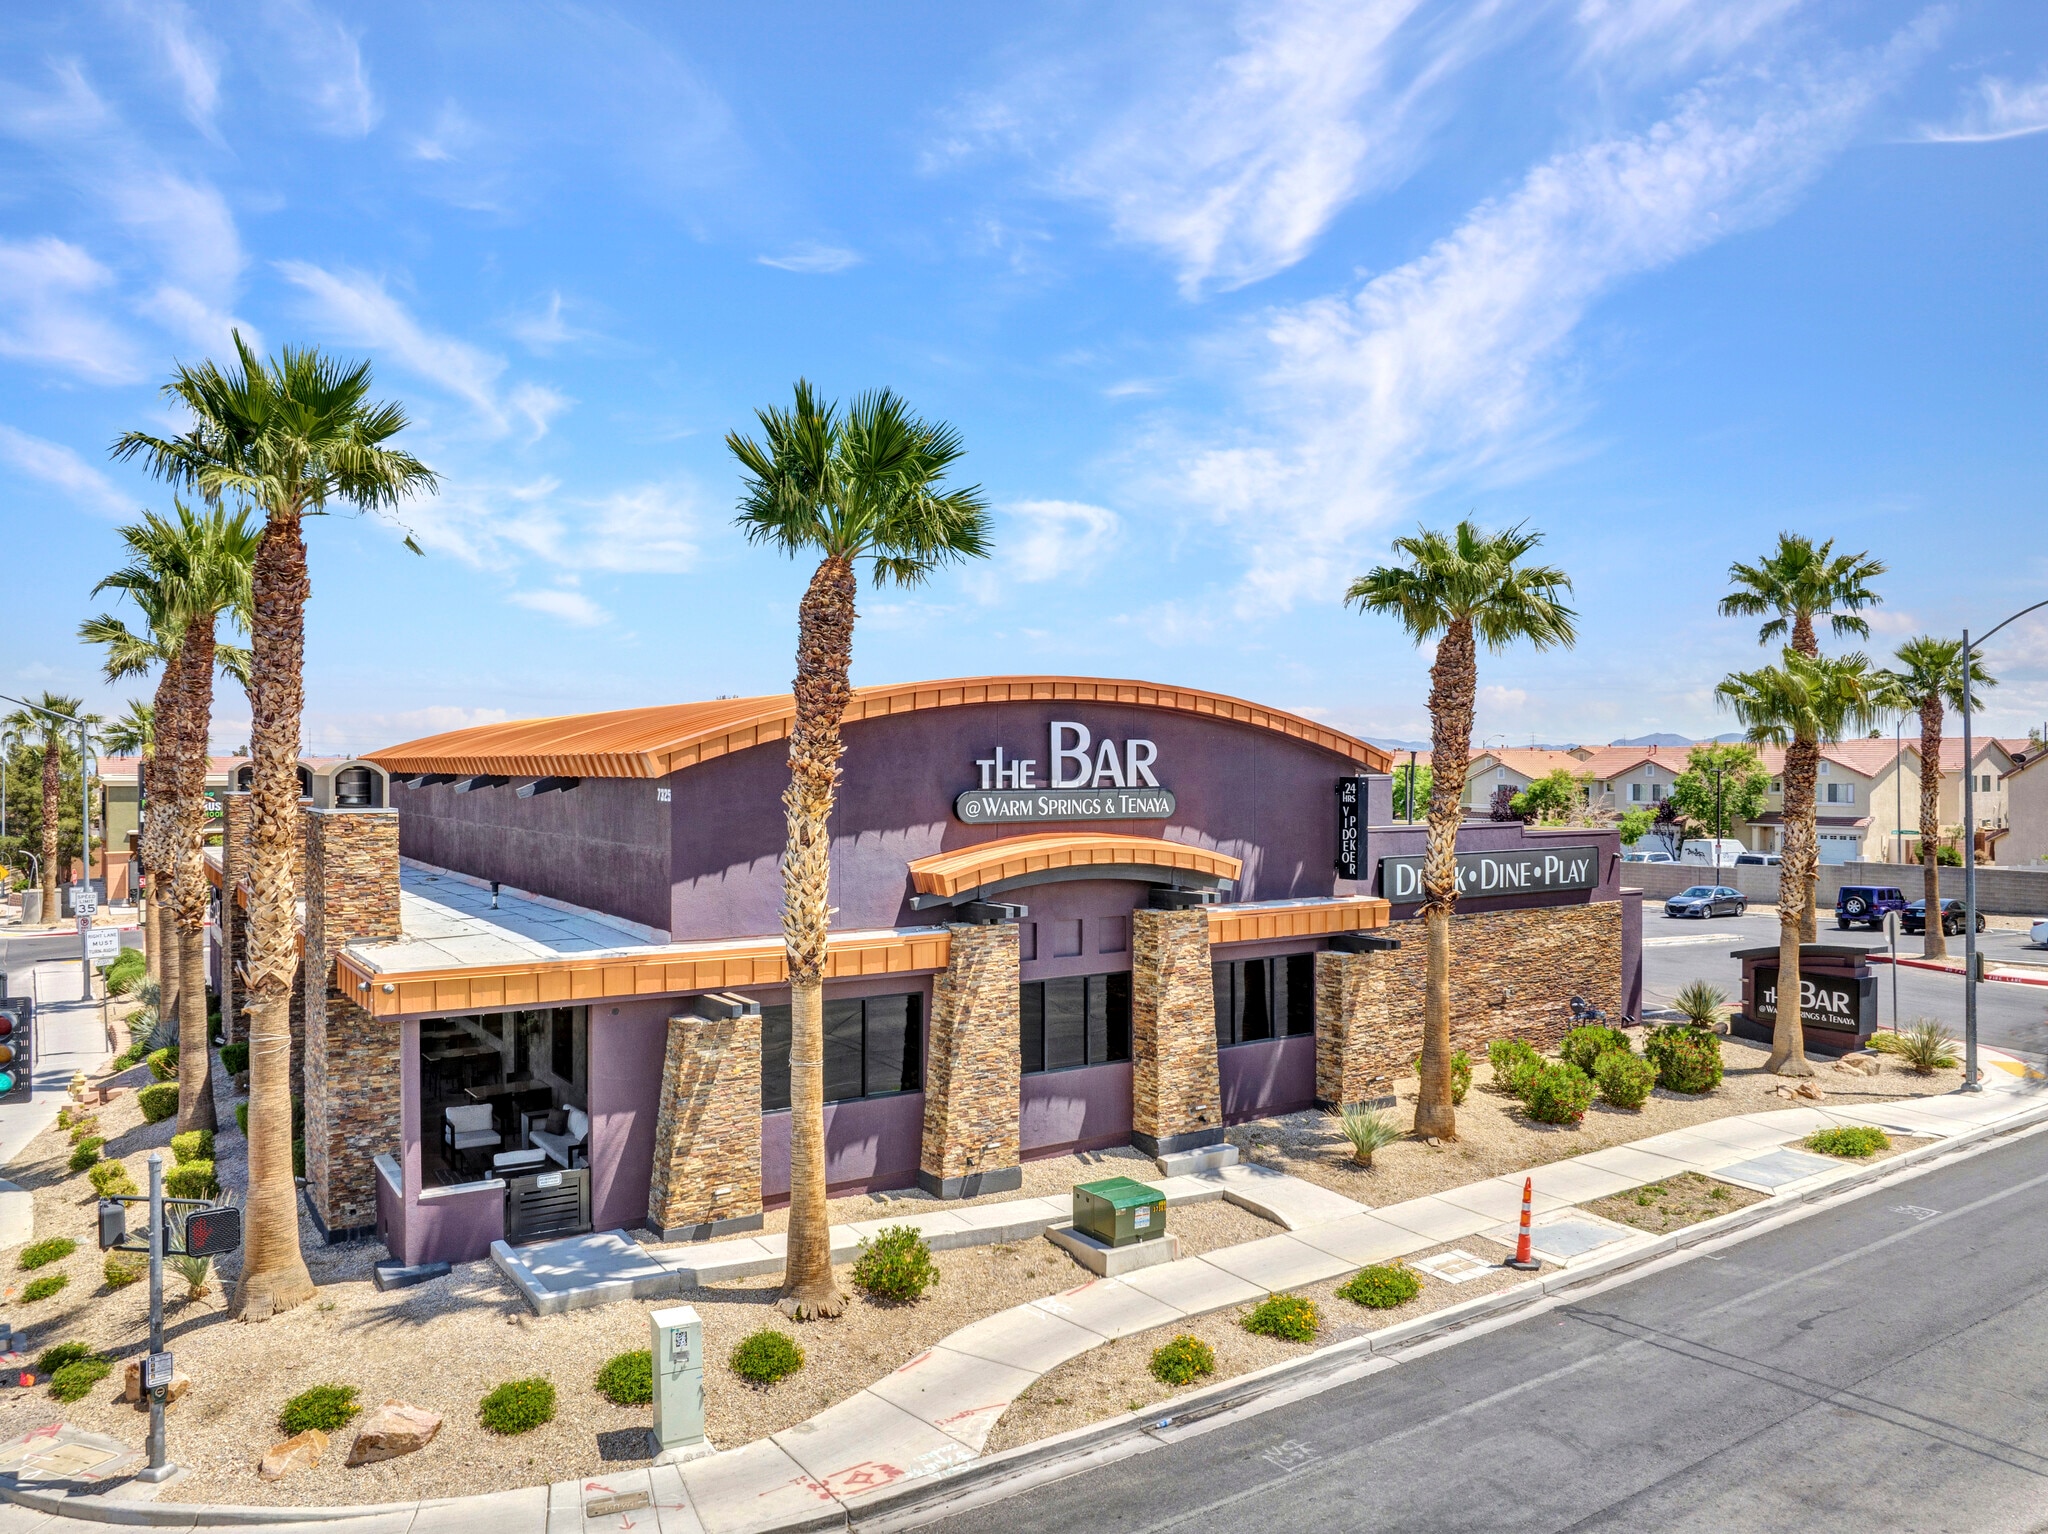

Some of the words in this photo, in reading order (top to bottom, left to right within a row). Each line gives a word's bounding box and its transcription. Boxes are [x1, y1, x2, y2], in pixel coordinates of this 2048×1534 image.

[976, 747, 1036, 789] THE
[1050, 721, 1160, 788] BAR
[1342, 791, 1356, 802] HRS
[1344, 783, 1357, 794] 24
[965, 801, 980, 817] @
[982, 797, 1033, 816] WARM
[1038, 796, 1101, 815] SPRINGS
[1105, 800, 1115, 814] &
[1118, 795, 1169, 813] TENAYA
[1341, 806, 1350, 863] VIDEO
[1349, 816, 1357, 874] POKER
[1481, 859, 1531, 890] DINE
[1545, 855, 1589, 885] PLAY
[78, 904, 96, 913] 35
[1763, 986, 1778, 1003] TH
[1800, 980, 1850, 1014] BAR
[1766, 1005, 1778, 1014] WA
[1800, 1011, 1820, 1020] RINGS
[1828, 1013, 1855, 1025] TENAYA
